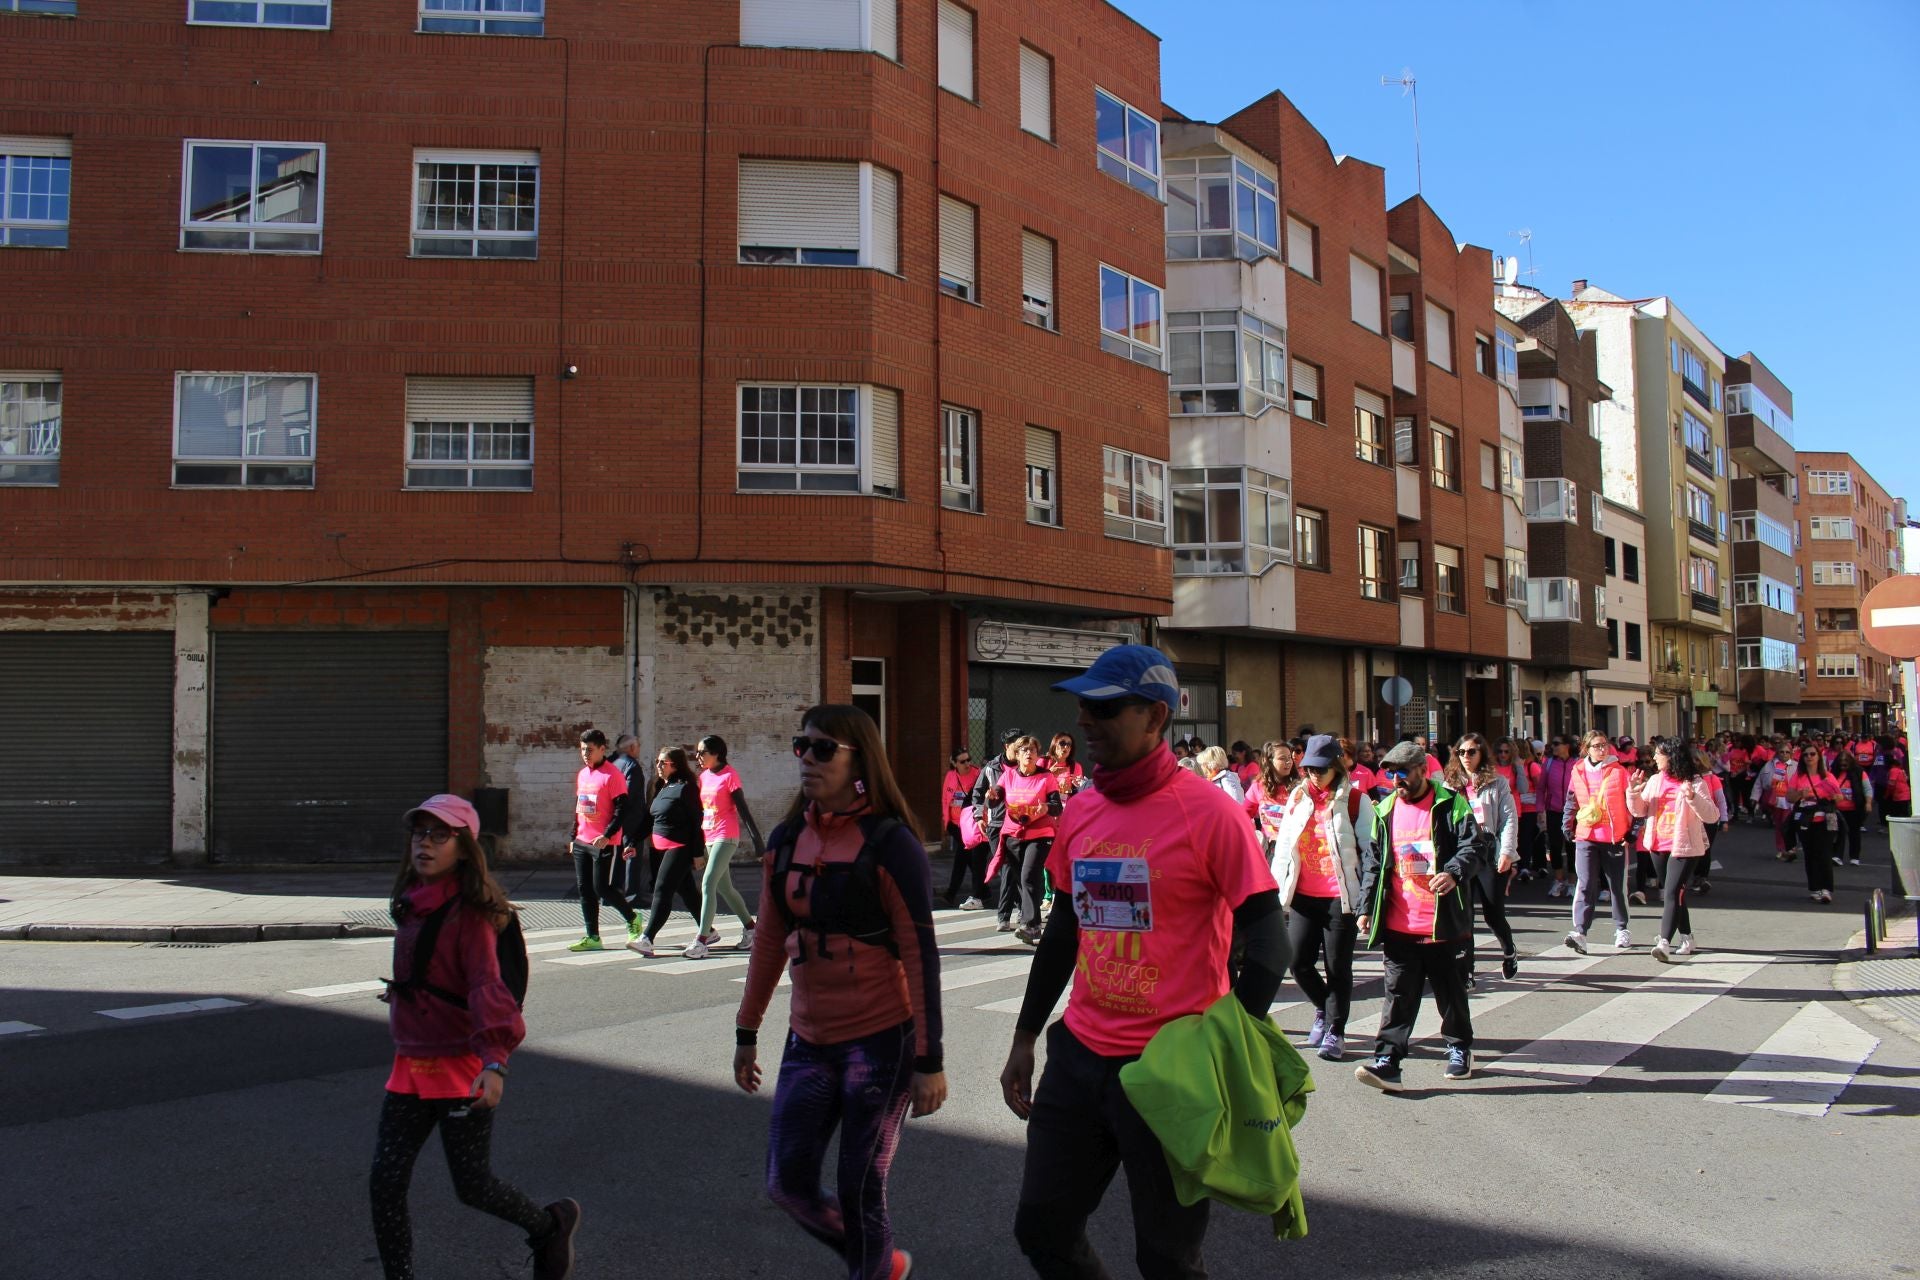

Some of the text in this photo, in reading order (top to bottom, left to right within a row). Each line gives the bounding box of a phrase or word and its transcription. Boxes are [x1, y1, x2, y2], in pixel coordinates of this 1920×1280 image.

[1099, 884, 1135, 900] 4010
[1095, 956, 1159, 980] Carrera
[1108, 976, 1159, 996] Mujer
